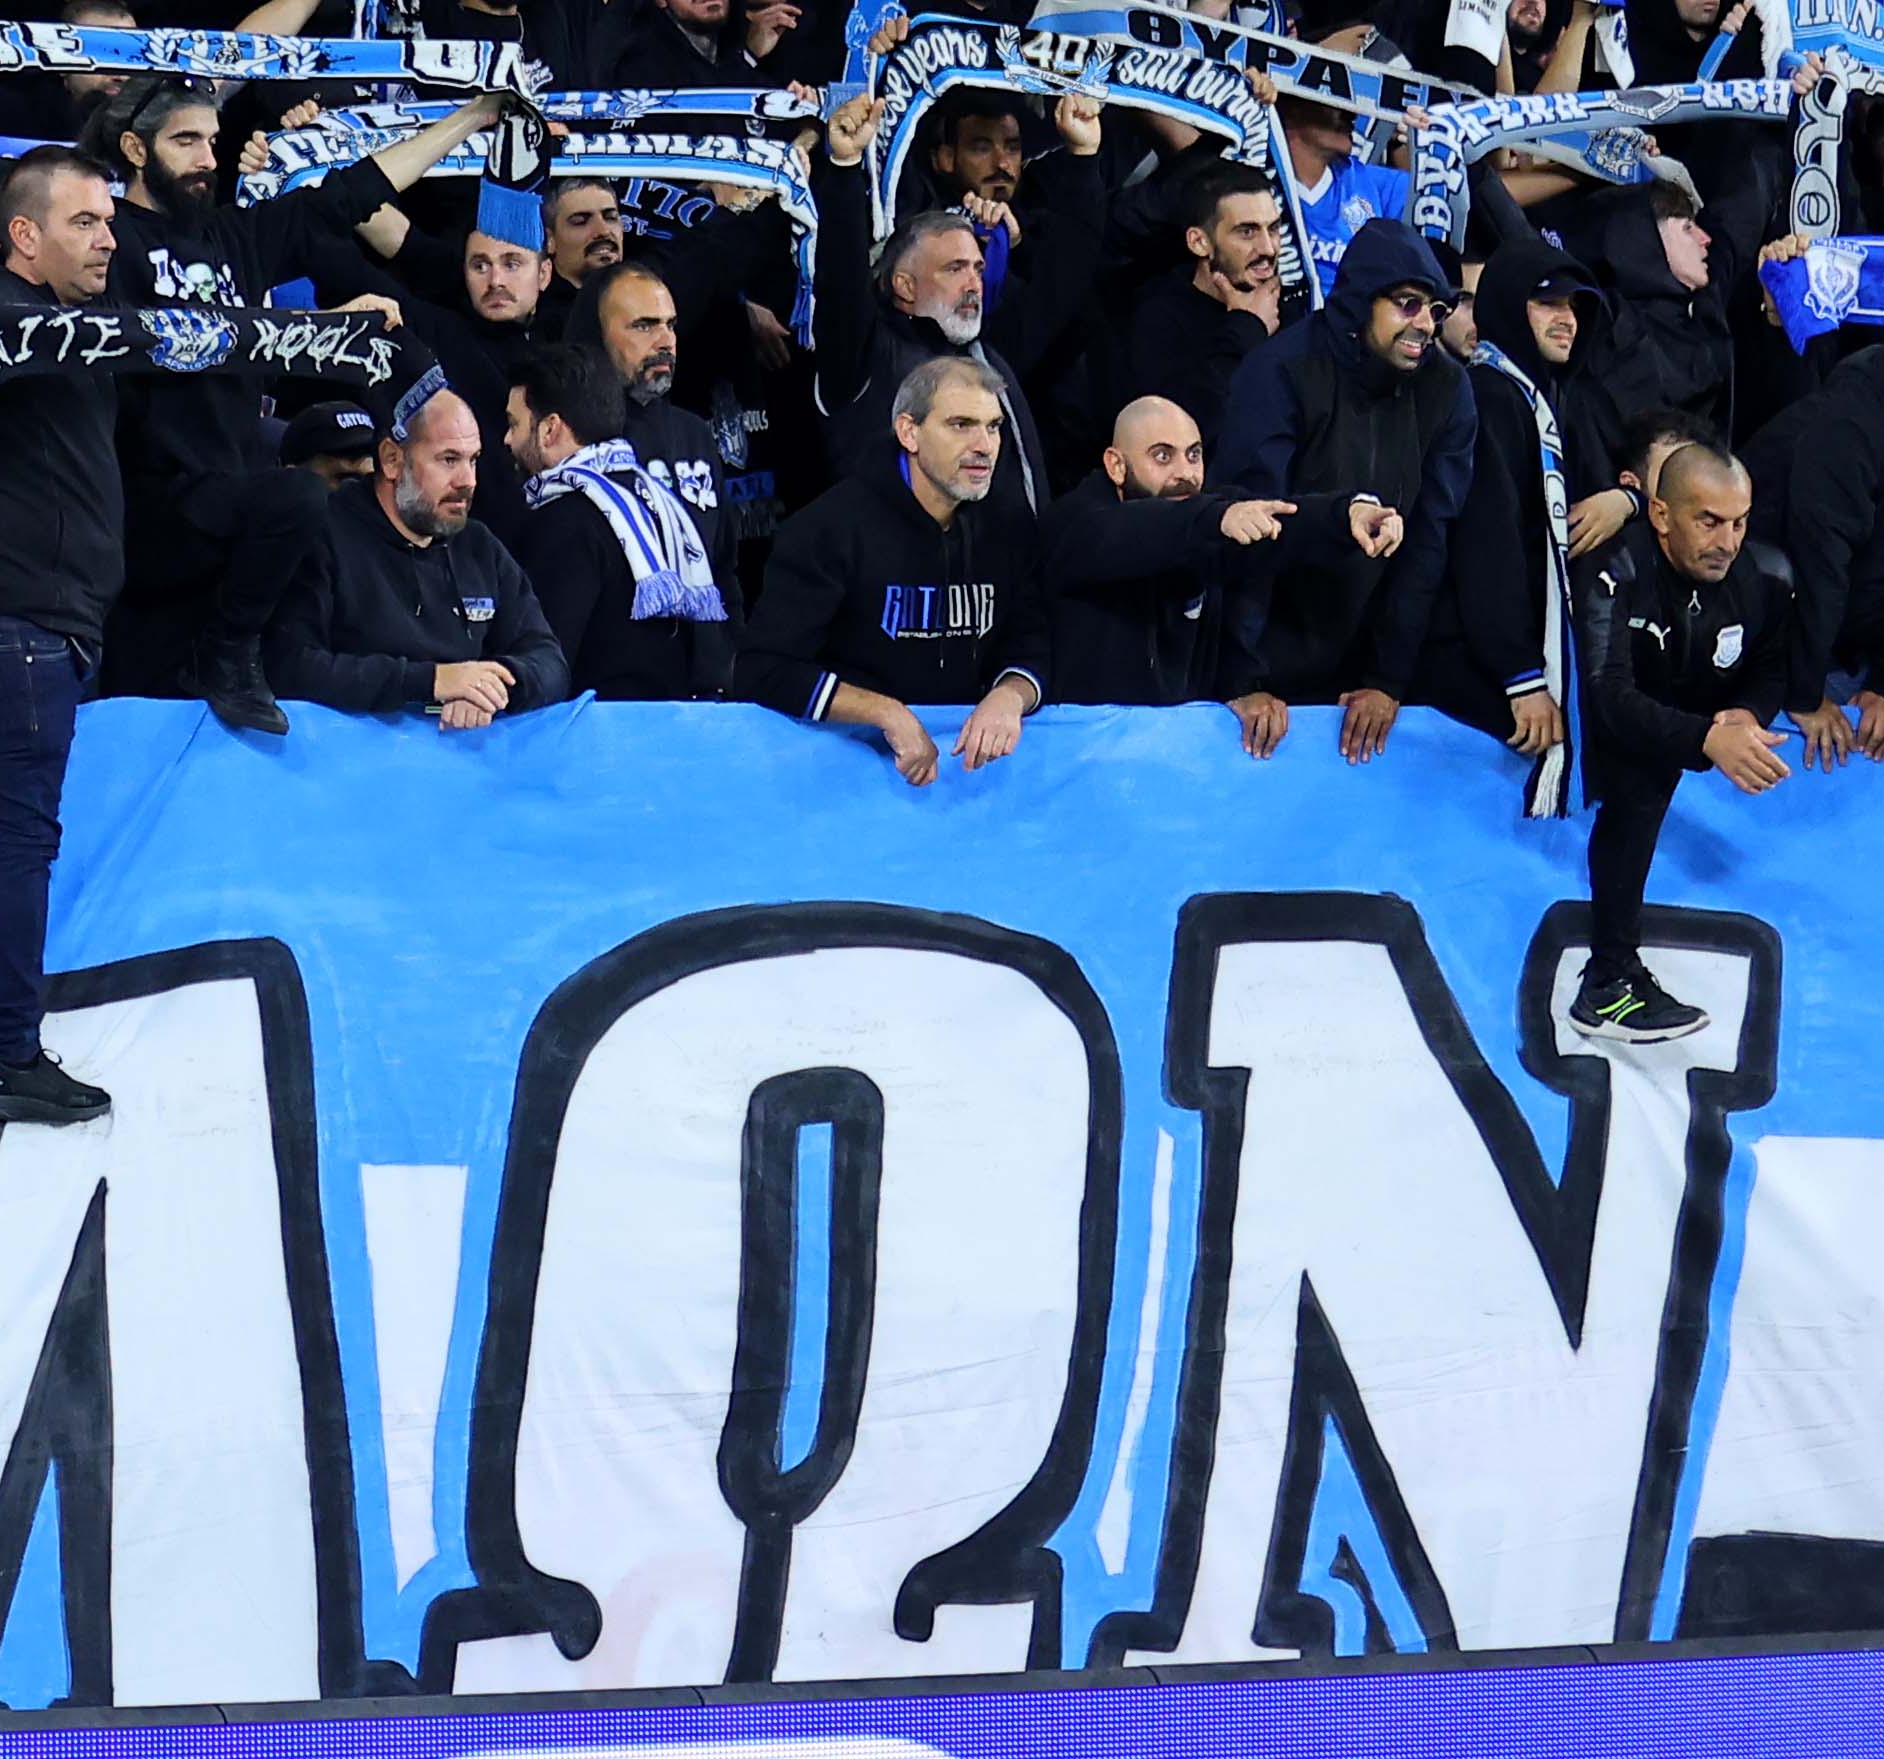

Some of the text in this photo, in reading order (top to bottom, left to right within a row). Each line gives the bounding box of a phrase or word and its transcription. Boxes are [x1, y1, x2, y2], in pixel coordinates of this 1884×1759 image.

[909, 23, 1185, 90] years 40 still
